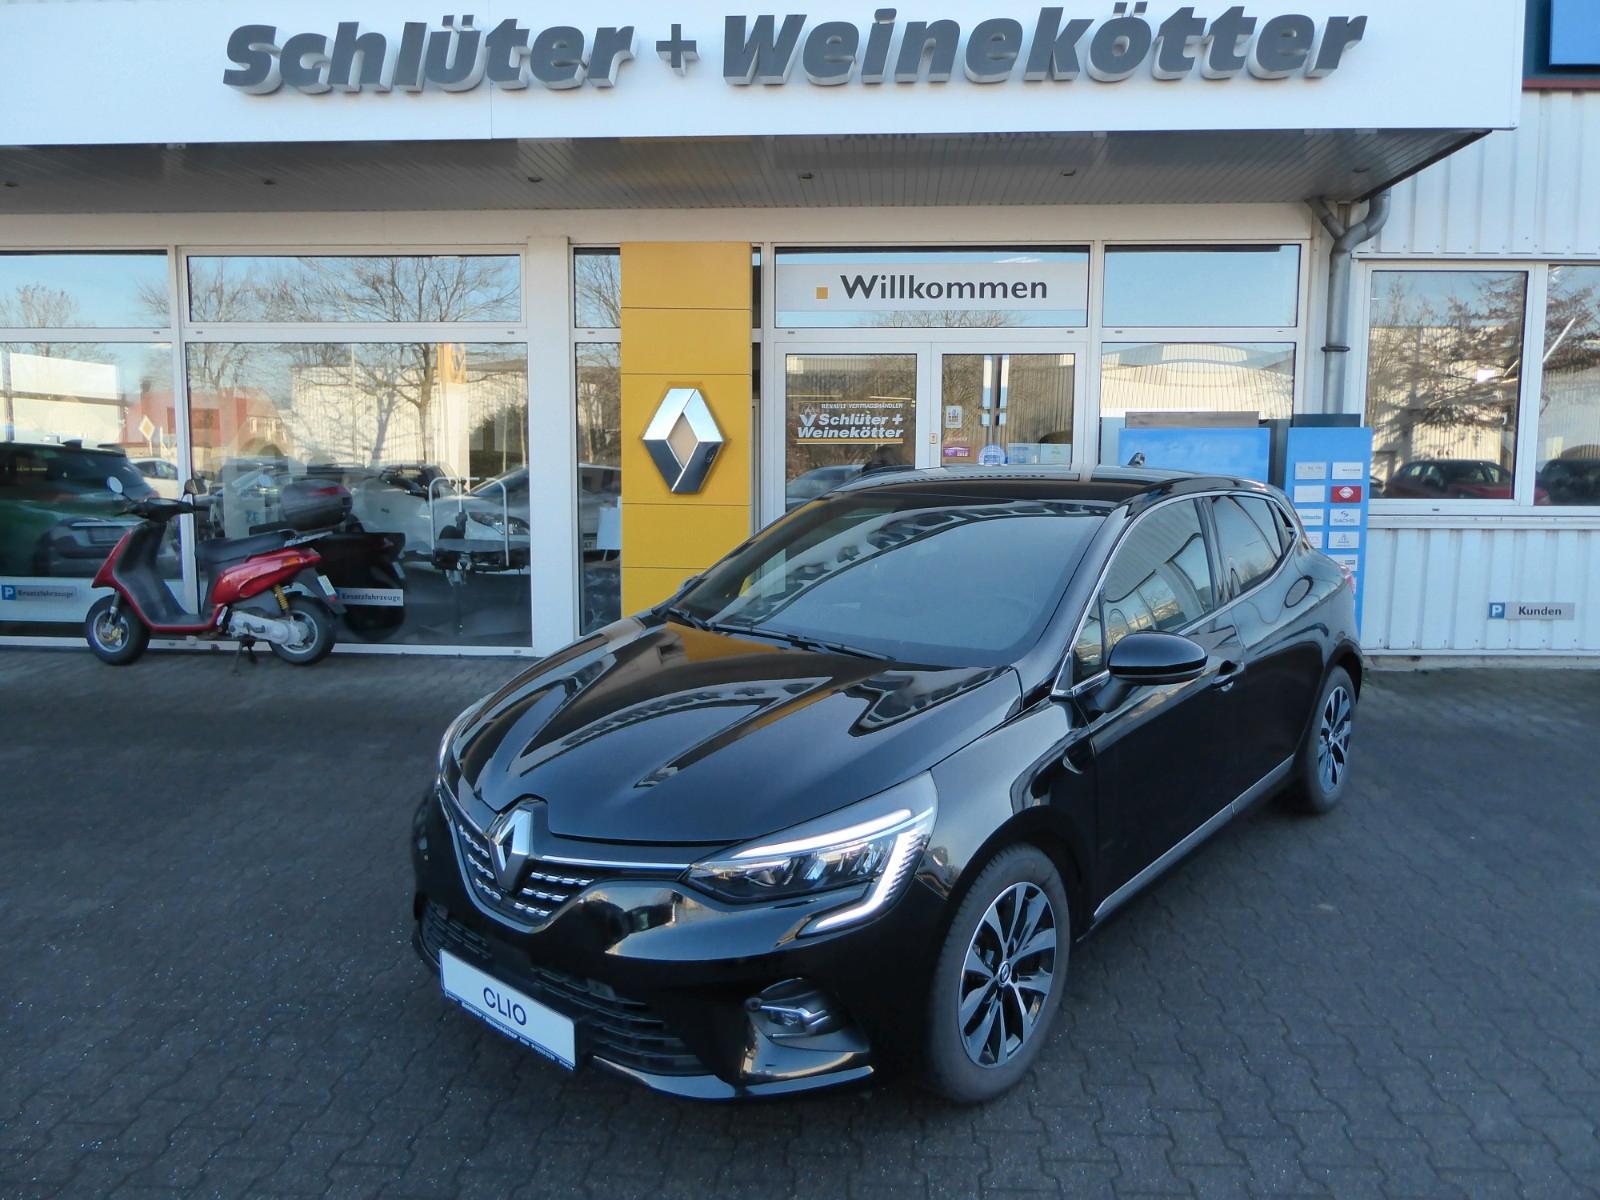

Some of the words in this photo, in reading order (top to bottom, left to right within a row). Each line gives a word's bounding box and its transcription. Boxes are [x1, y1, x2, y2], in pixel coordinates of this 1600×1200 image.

[223, 15, 635, 95] Schlüter
[656, 23, 700, 77] +
[723, 1, 1368, 86] Weinekötter
[840, 274, 1048, 299] Willkommen
[818, 413, 888, 426] Schlüter
[892, 414, 904, 425] +
[798, 427, 904, 438] Weinekötter
[1518, 606, 1562, 616] Kunden
[483, 987, 527, 1026] CLIO
